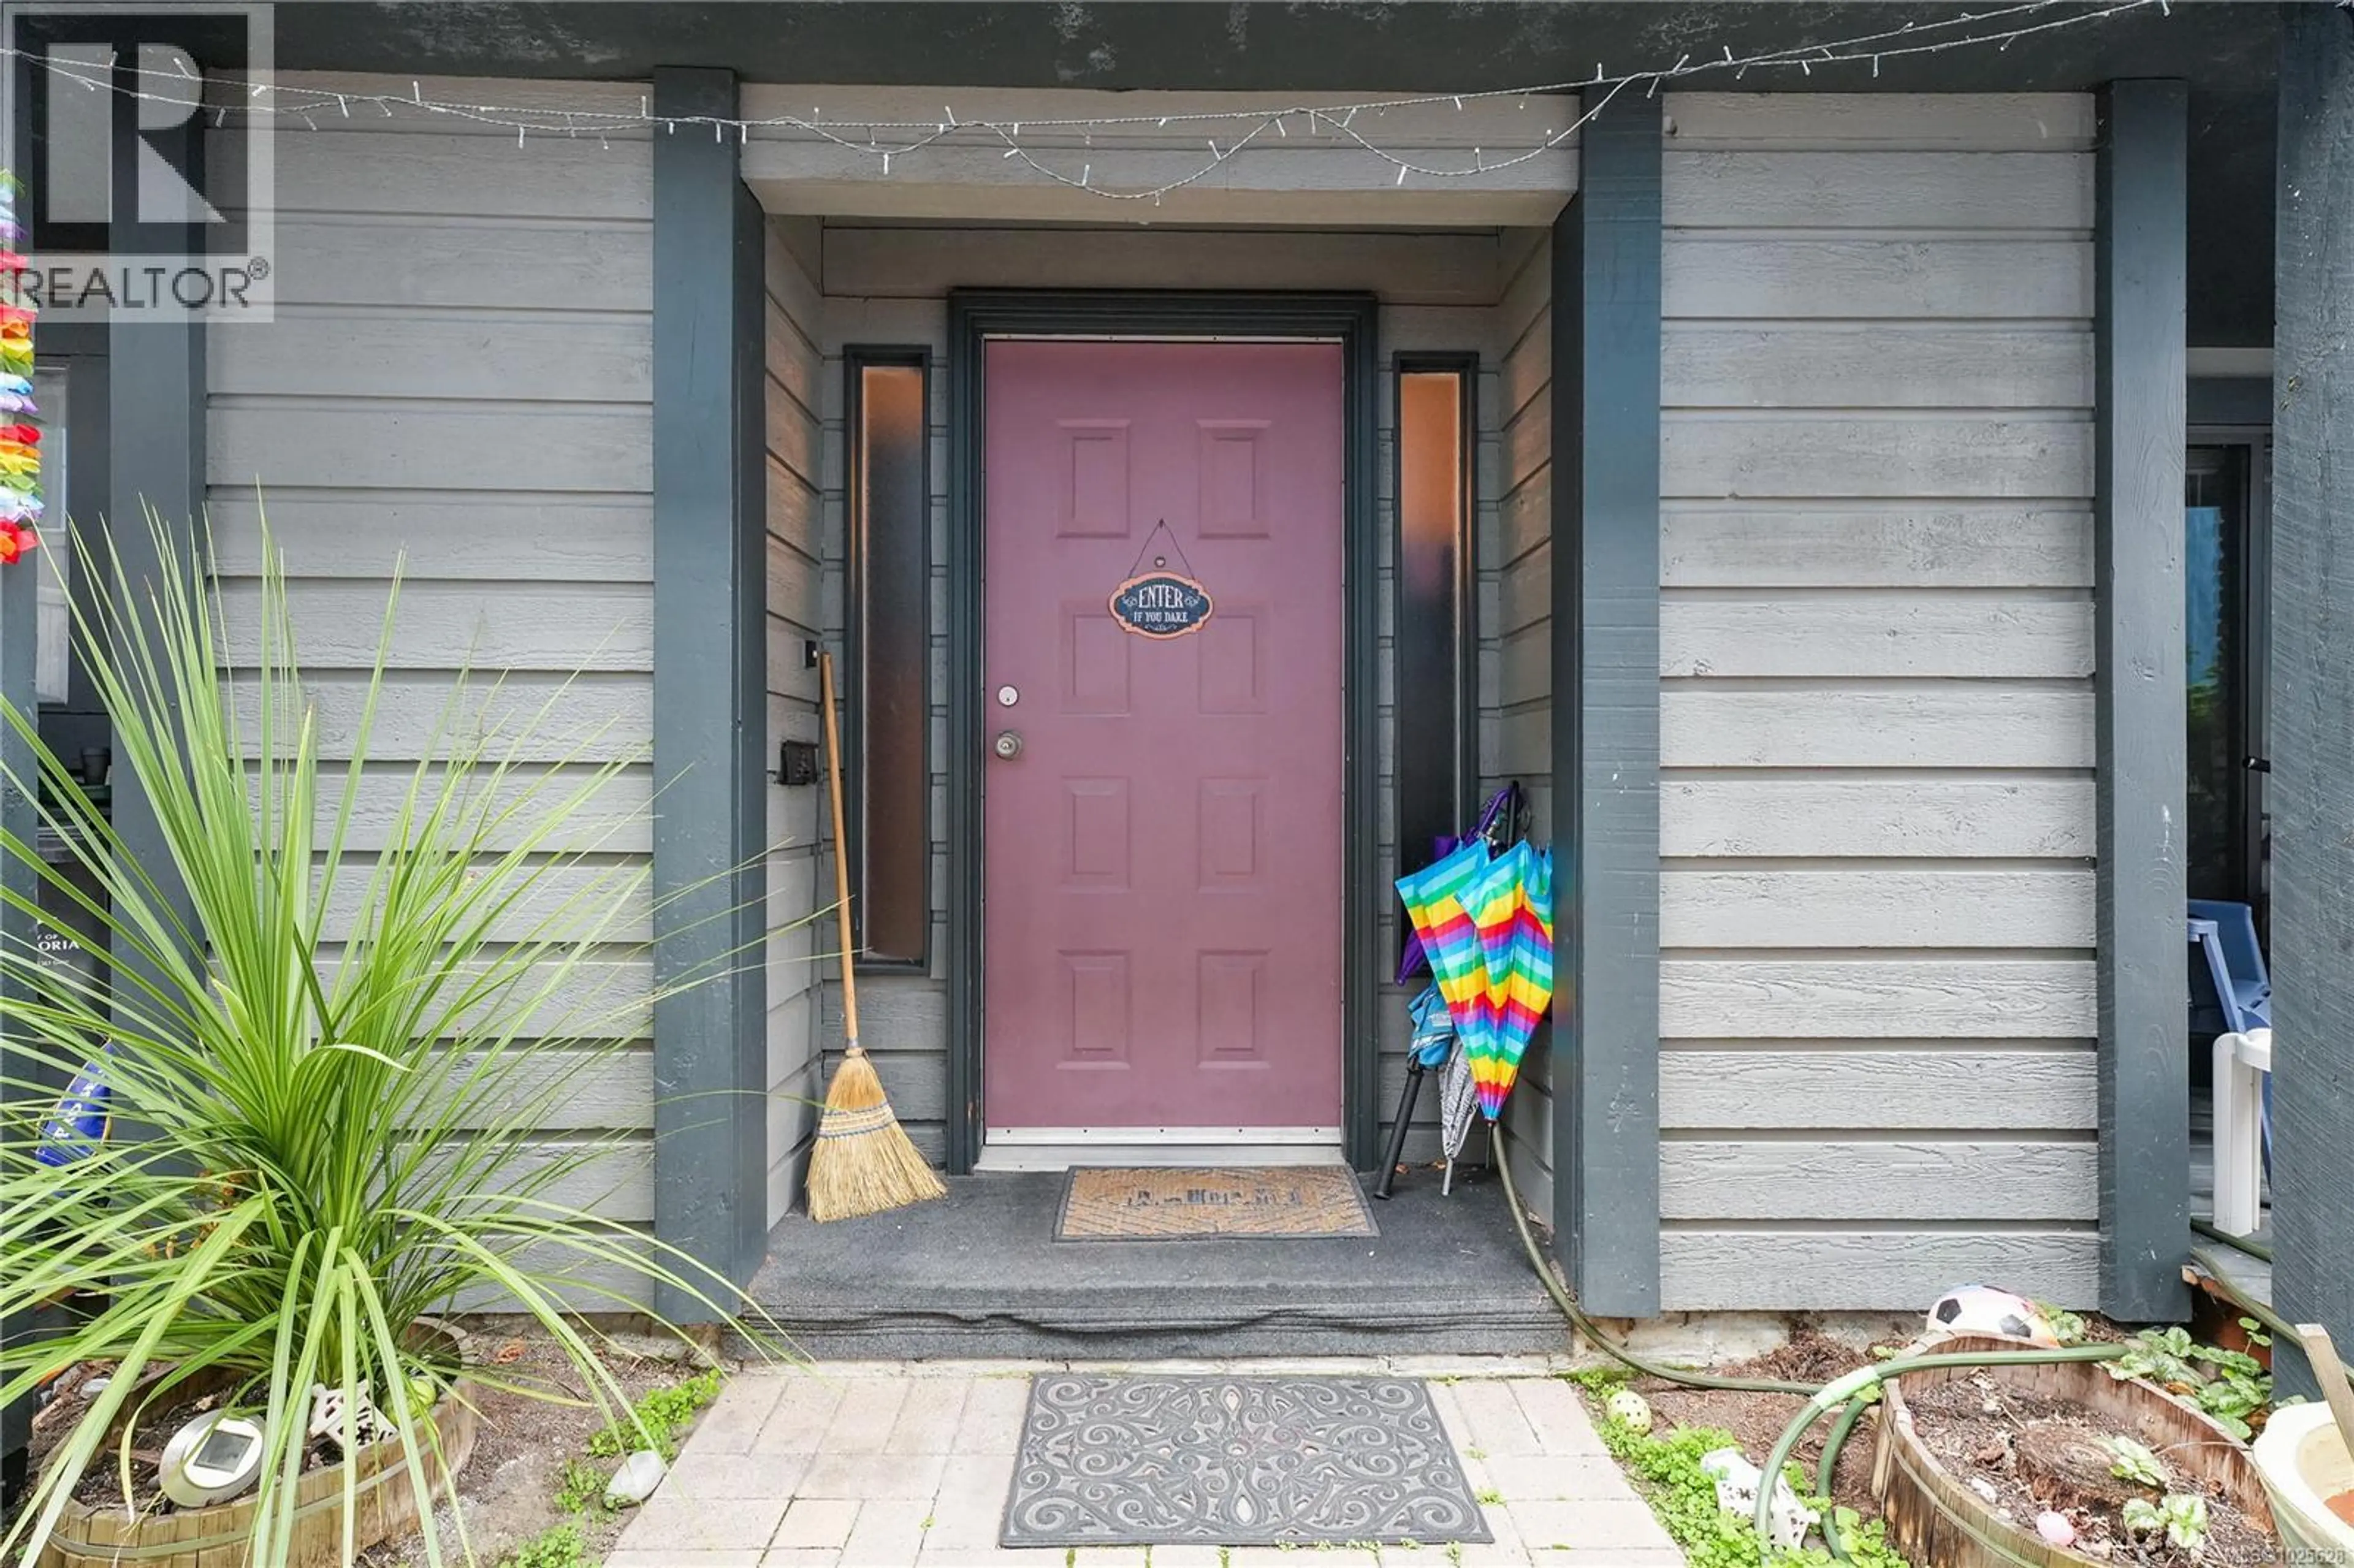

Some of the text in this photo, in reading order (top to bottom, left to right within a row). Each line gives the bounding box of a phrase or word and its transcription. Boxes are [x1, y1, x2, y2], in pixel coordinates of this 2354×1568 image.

[1138, 584, 1183, 608] ENTER
[1134, 612, 1188, 622] IF YOU DARE
[37, 940, 80, 950] ORIA
